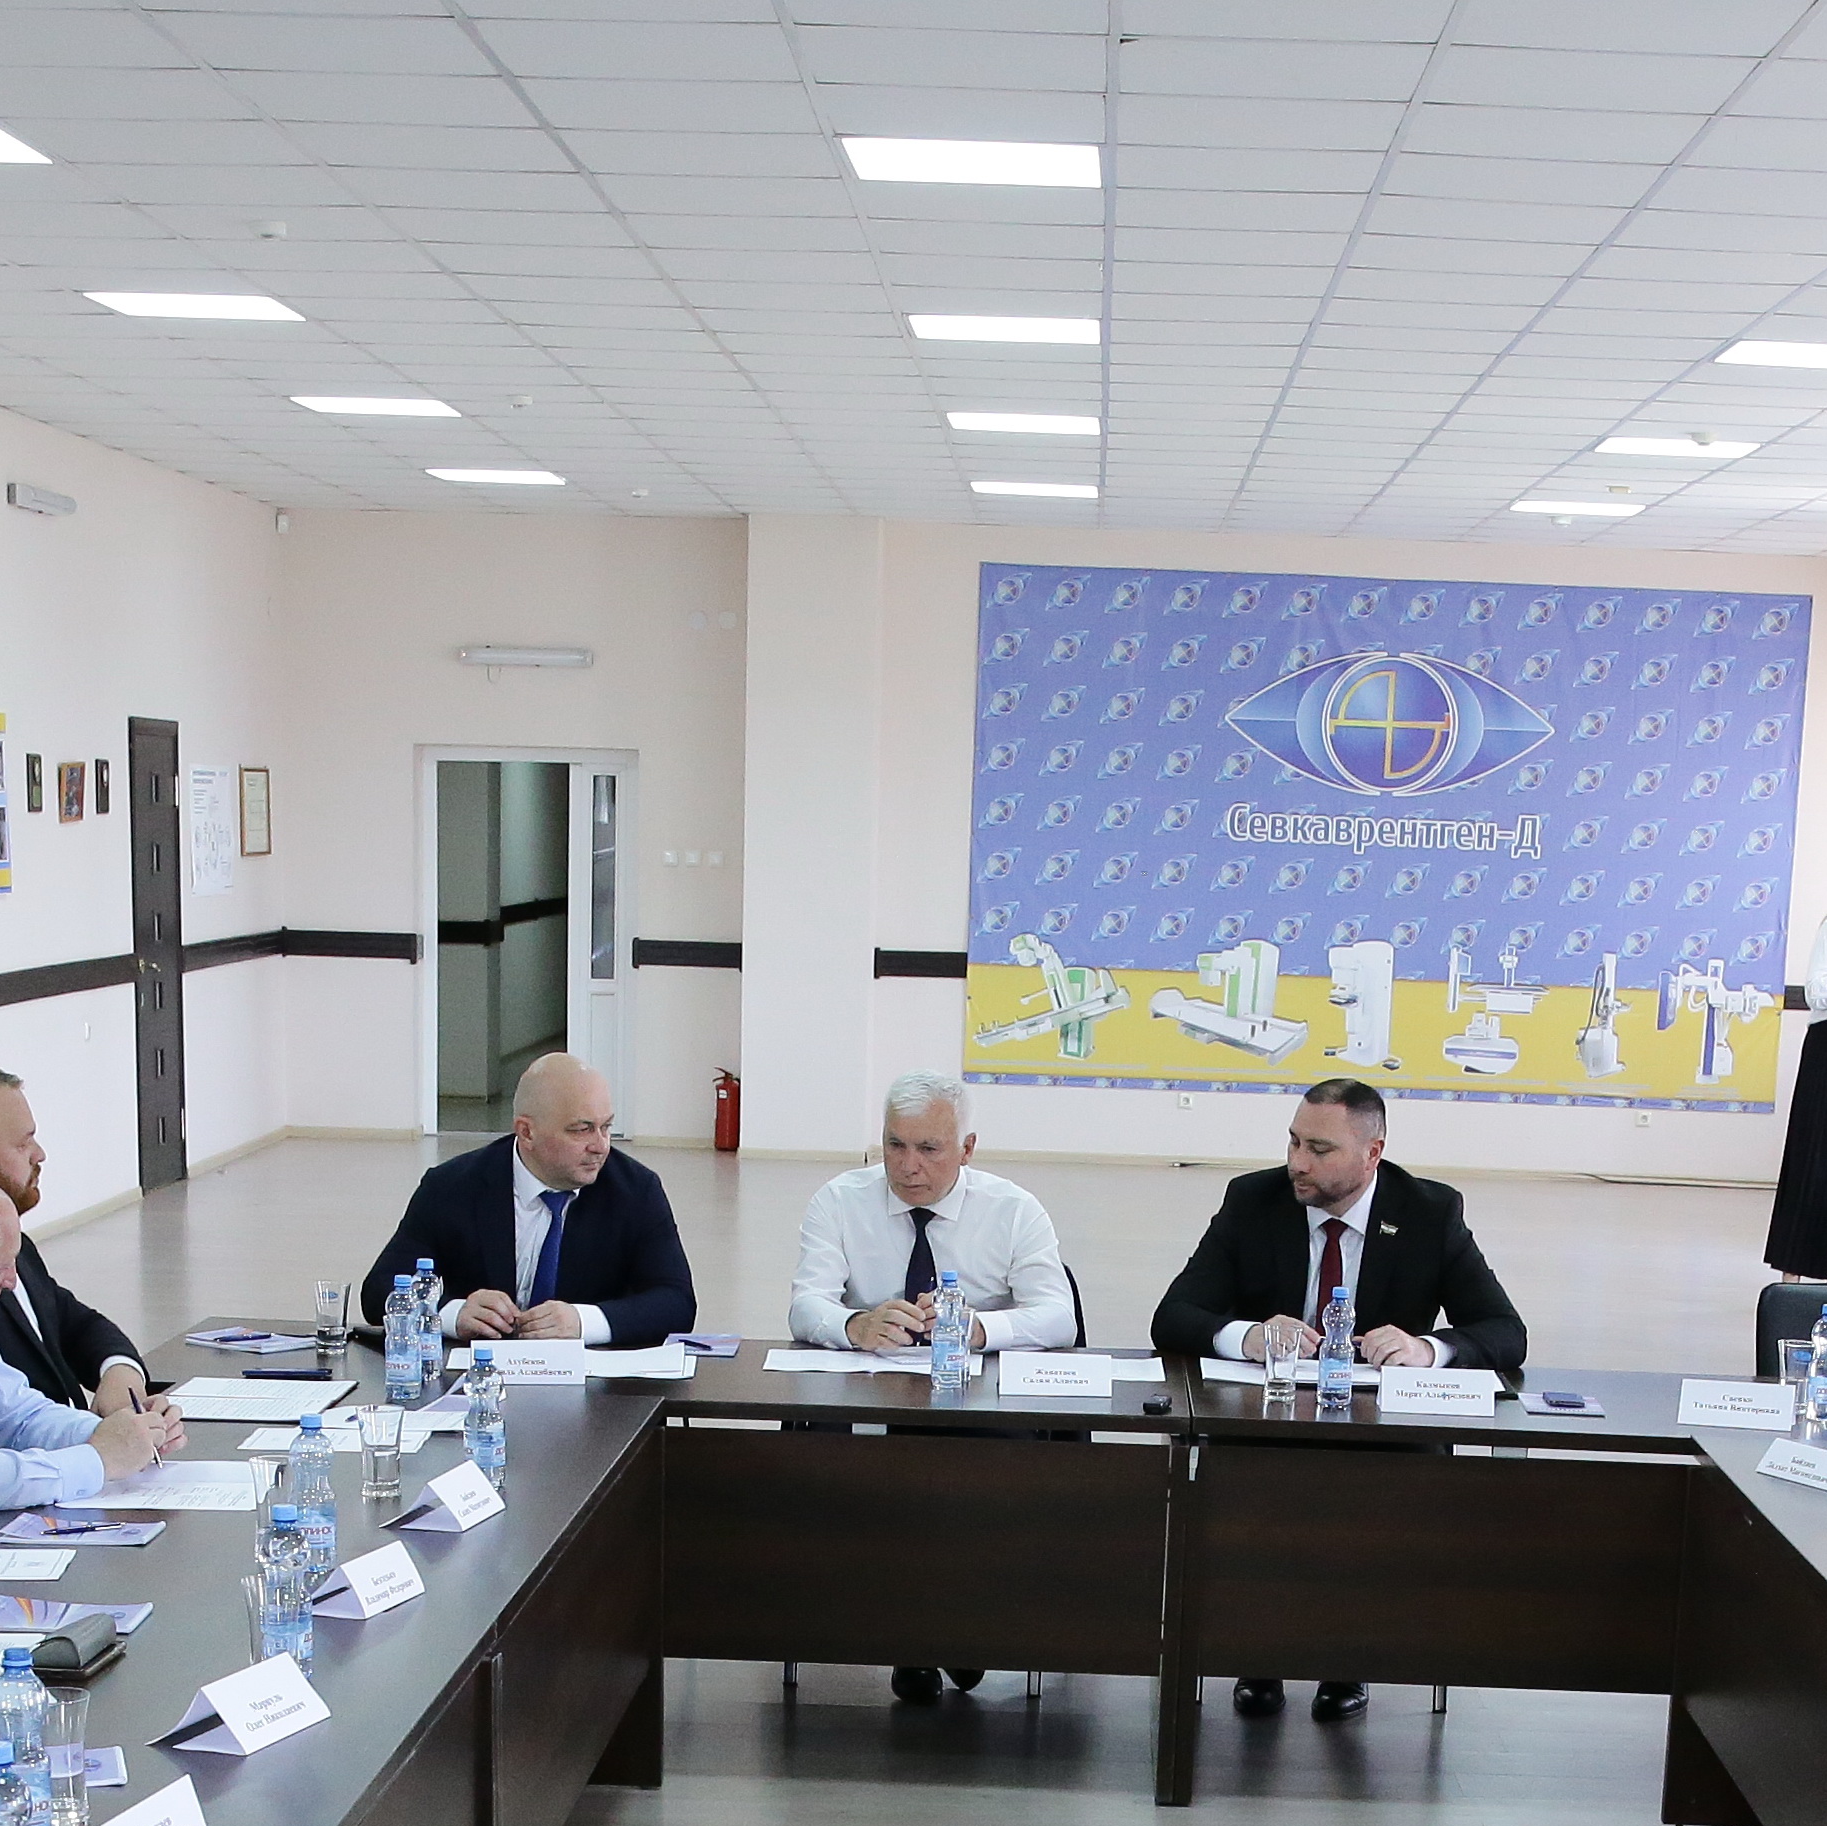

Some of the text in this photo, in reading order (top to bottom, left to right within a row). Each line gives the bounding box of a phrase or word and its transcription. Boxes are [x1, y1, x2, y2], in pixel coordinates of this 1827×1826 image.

[1226, 802, 1542, 860] Севкаврентген-Д
[1396, 1390, 1422, 1398] Марат
[1693, 1401, 1728, 1411] Татьяна
